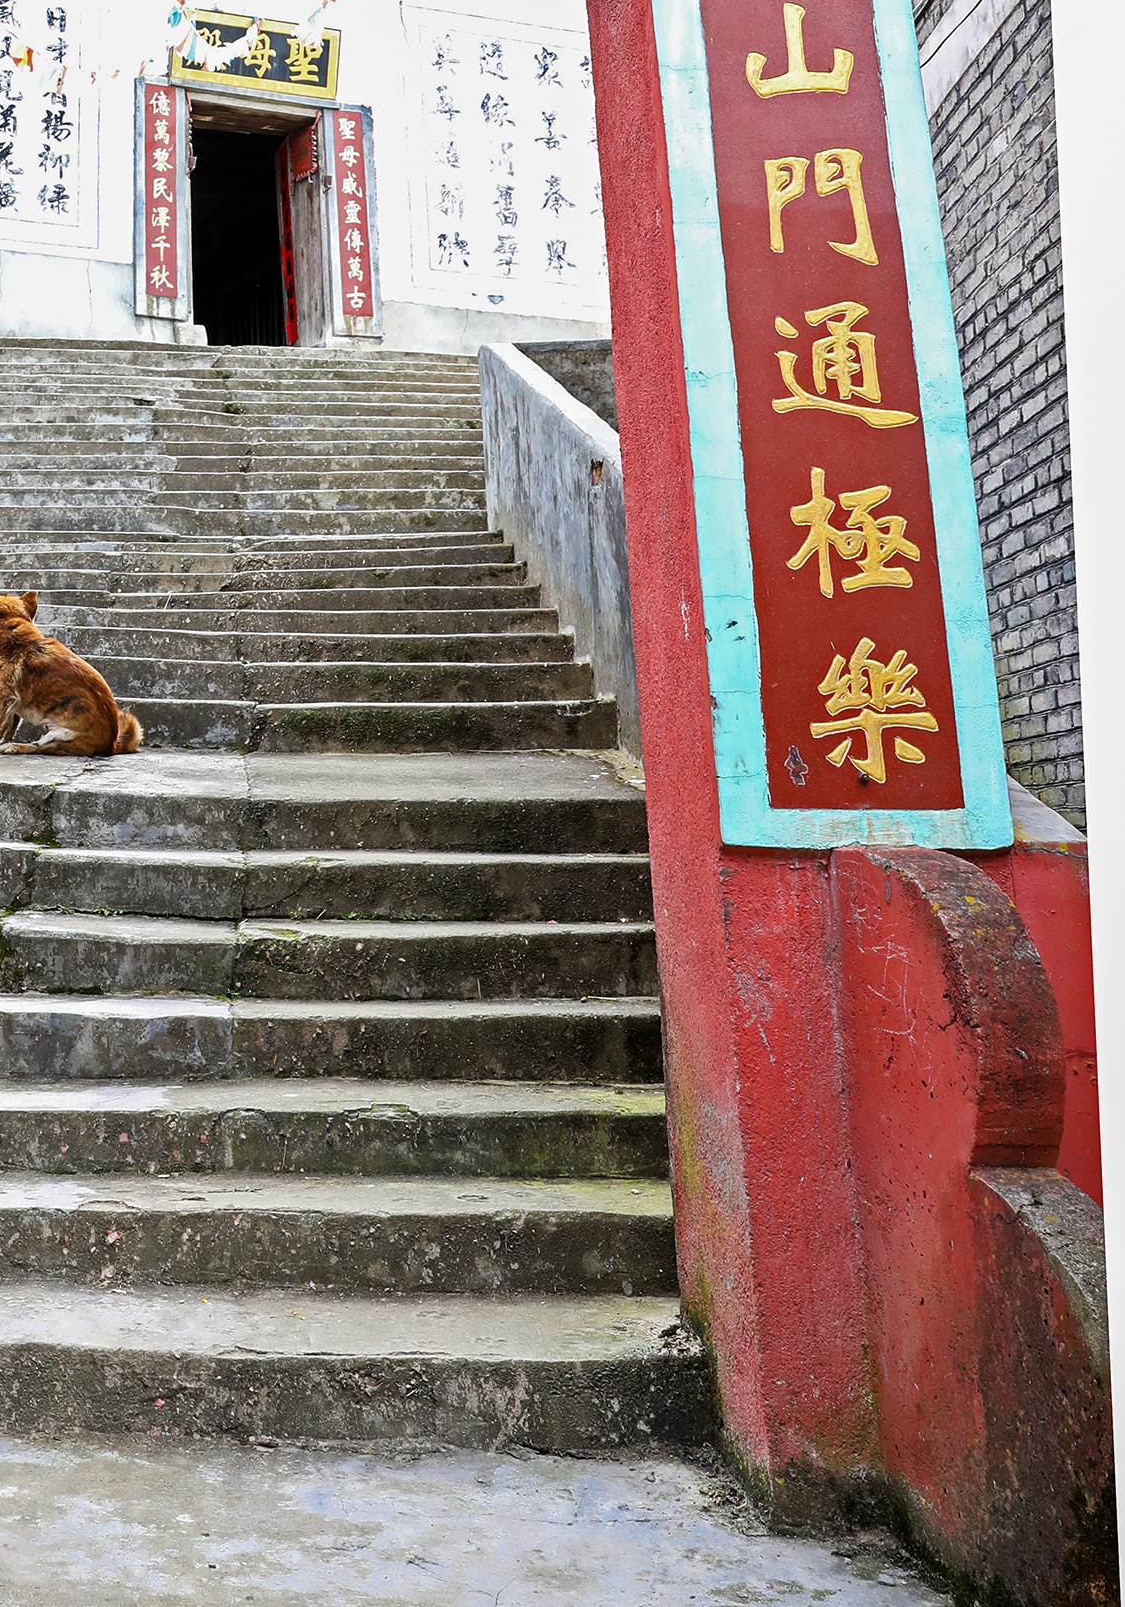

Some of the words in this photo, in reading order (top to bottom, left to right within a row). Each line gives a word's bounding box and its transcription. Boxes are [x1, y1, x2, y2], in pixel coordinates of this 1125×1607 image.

[149, 91, 174, 289] 億萬黎民澤千秋
[338, 116, 367, 310] 聖母威靈傳萬古
